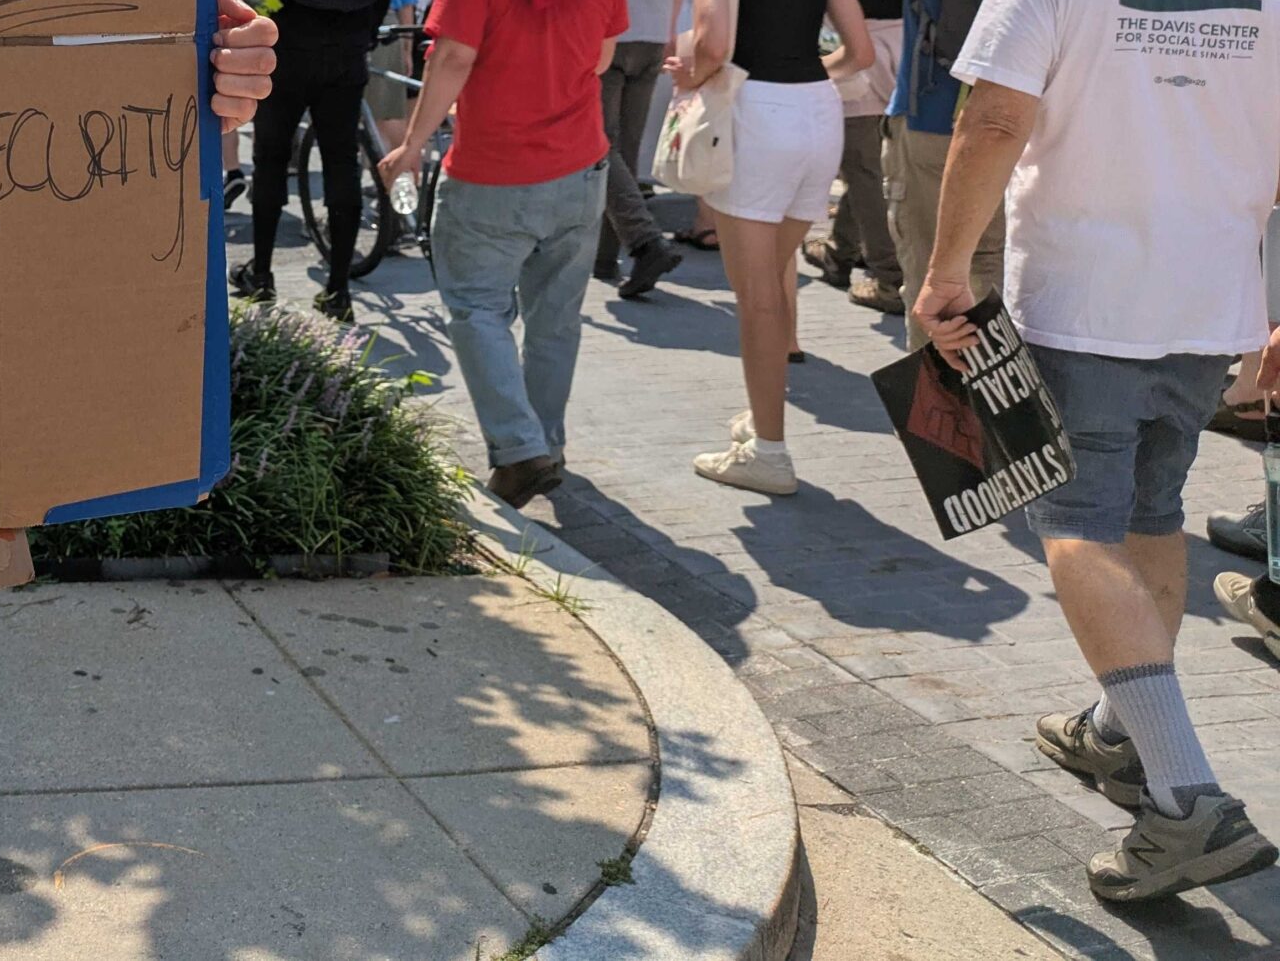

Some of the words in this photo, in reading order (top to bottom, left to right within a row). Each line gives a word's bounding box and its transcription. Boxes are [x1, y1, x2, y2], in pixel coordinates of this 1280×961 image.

[1117, 17, 1149, 31] THE
[1151, 18, 1196, 34] DAVIS
[1198, 22, 1260, 39] CENTER
[1115, 32, 1142, 43] FOR
[1147, 33, 1197, 47] SOCIAL
[1198, 38, 1256, 51] JUSTICE
[1140, 46, 1154, 55] AT
[1158, 47, 1198, 58] TEMPLE
[1200, 50, 1230, 60] SINAI
[971, 345, 1041, 416] RACIAL
[943, 443, 1068, 534] STATEHOOD
